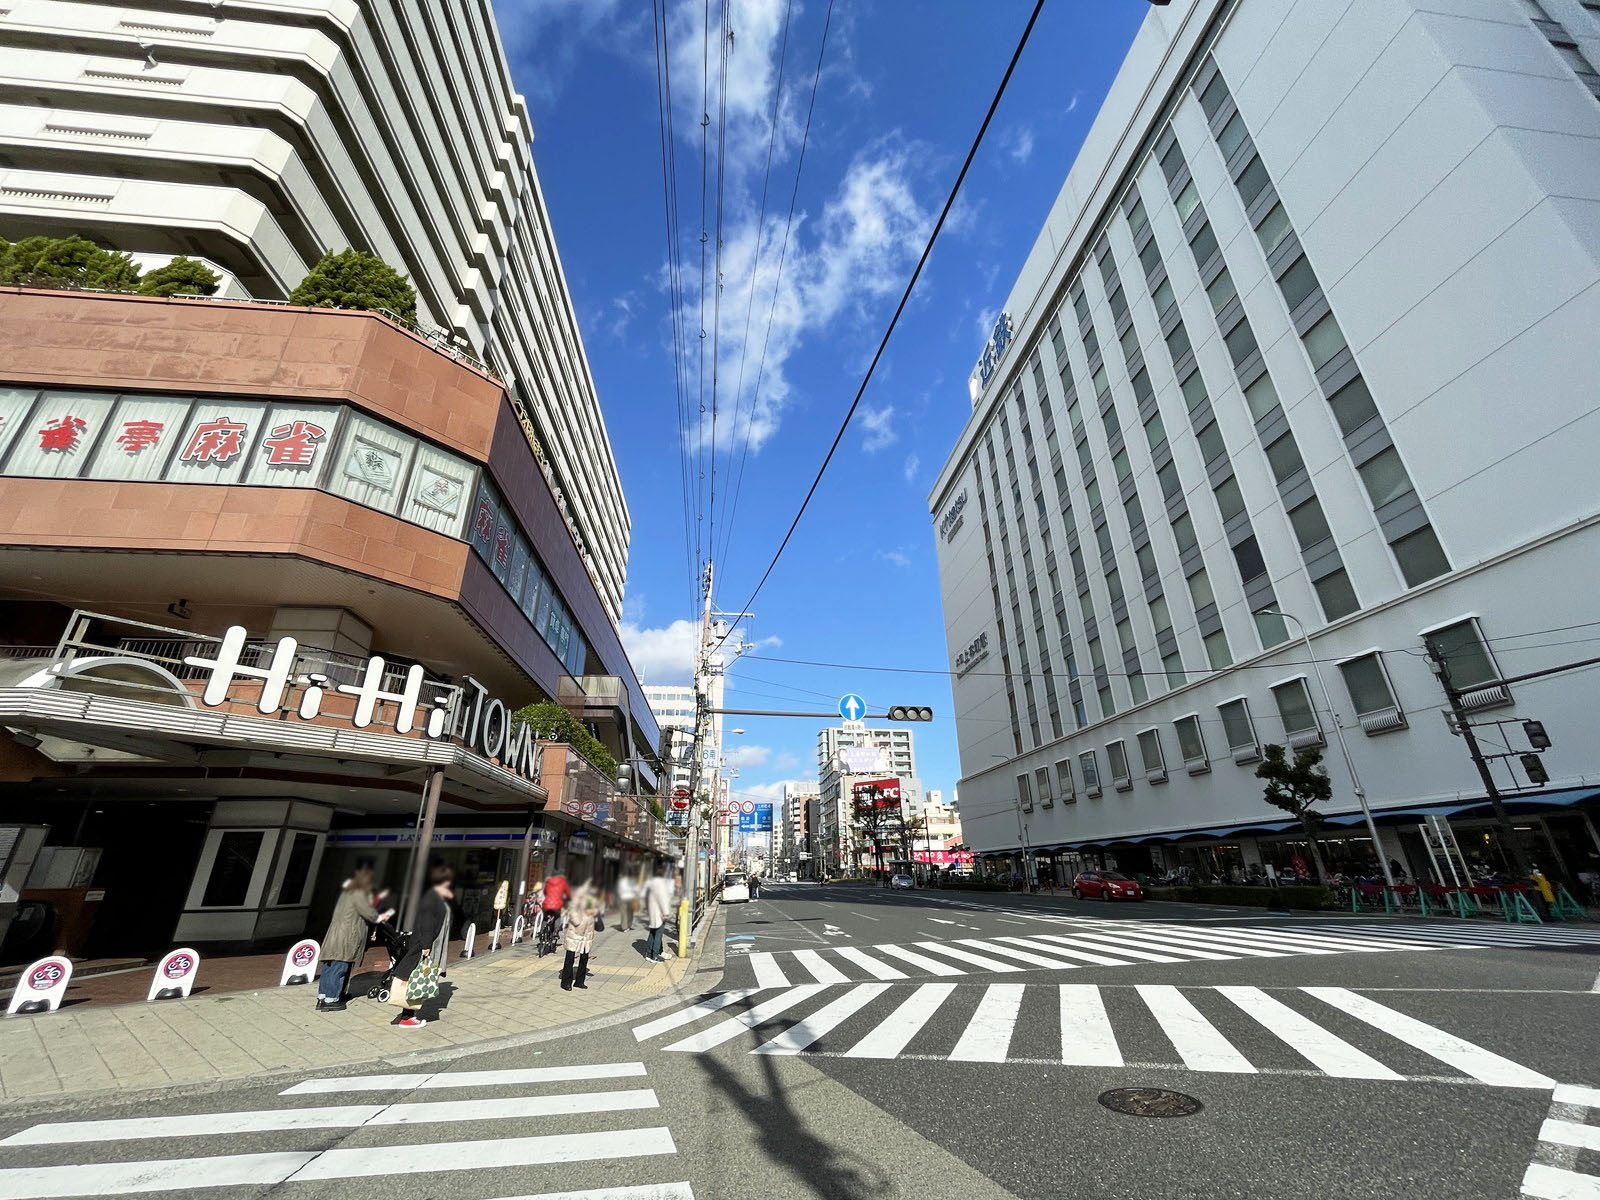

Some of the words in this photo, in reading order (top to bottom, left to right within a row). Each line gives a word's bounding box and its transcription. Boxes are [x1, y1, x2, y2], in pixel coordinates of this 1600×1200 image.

[180, 416, 327, 466] 麻雀
[474, 497, 511, 570] 麻雀
[464, 676, 538, 778] TOWN
